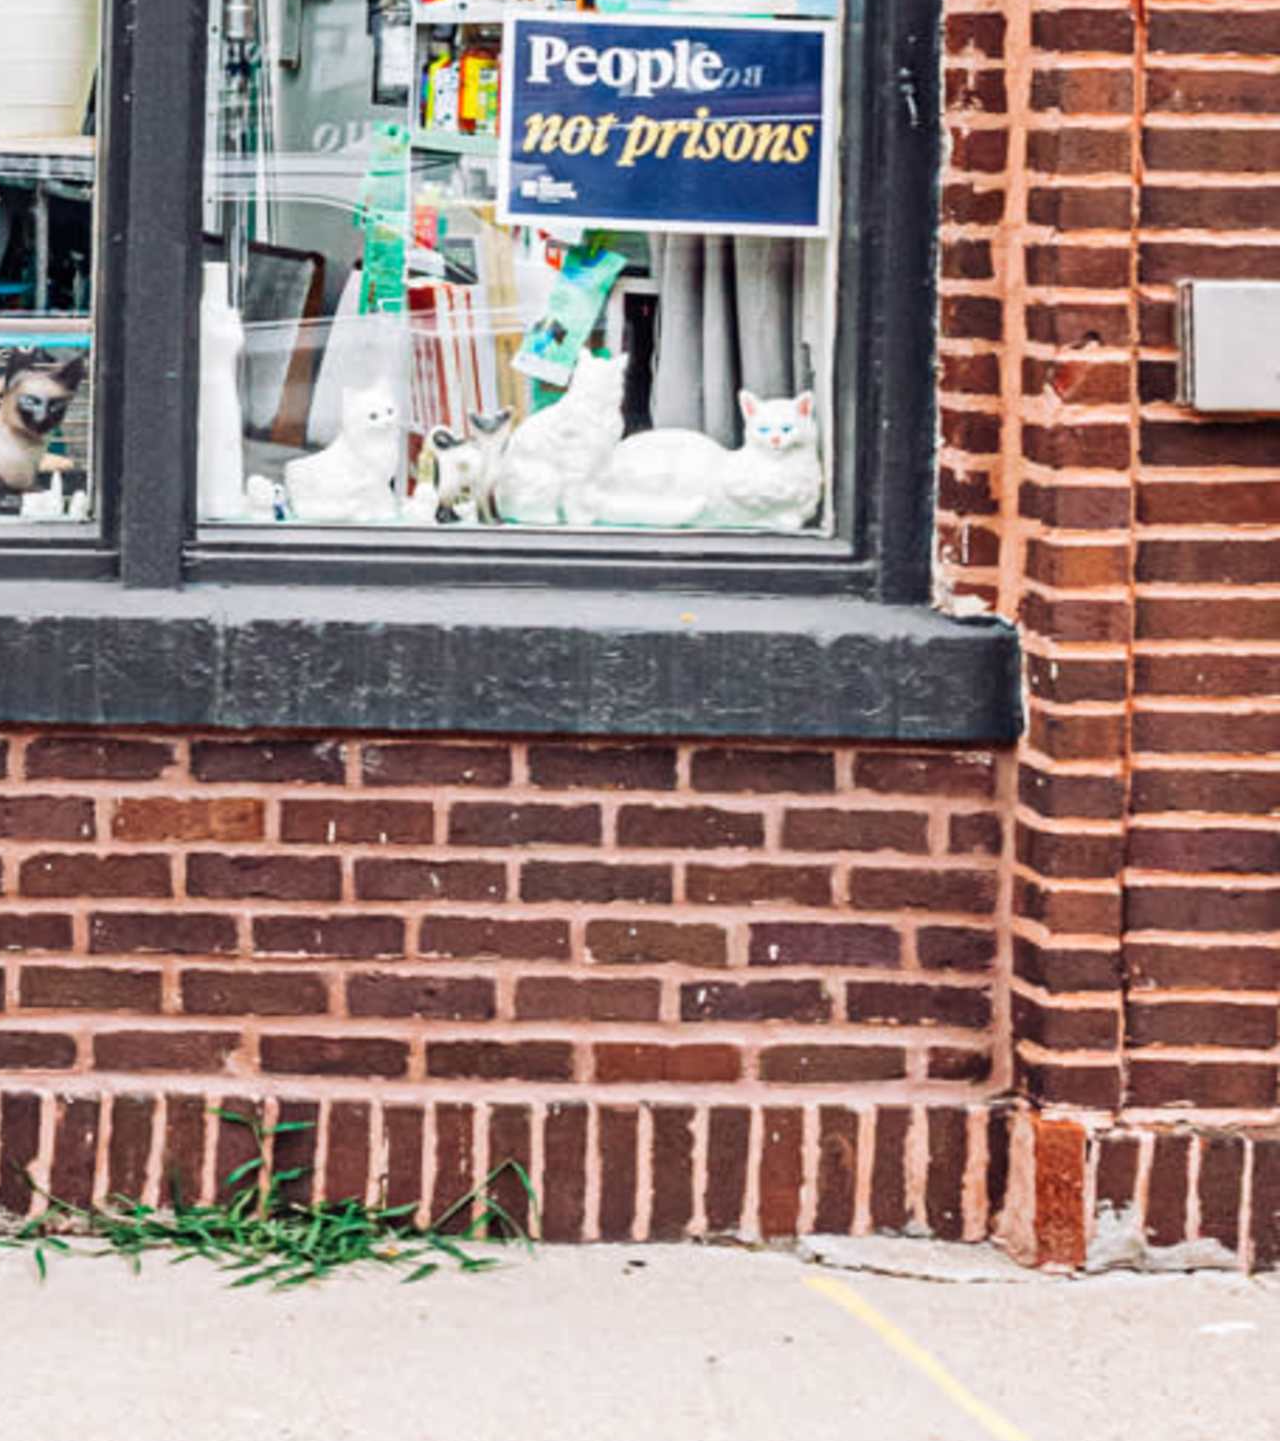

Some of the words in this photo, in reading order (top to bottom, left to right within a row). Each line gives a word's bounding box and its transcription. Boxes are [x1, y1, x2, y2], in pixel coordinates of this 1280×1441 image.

[526, 34, 724, 98] People
[522, 112, 619, 156] not
[616, 106, 814, 167] prisons
